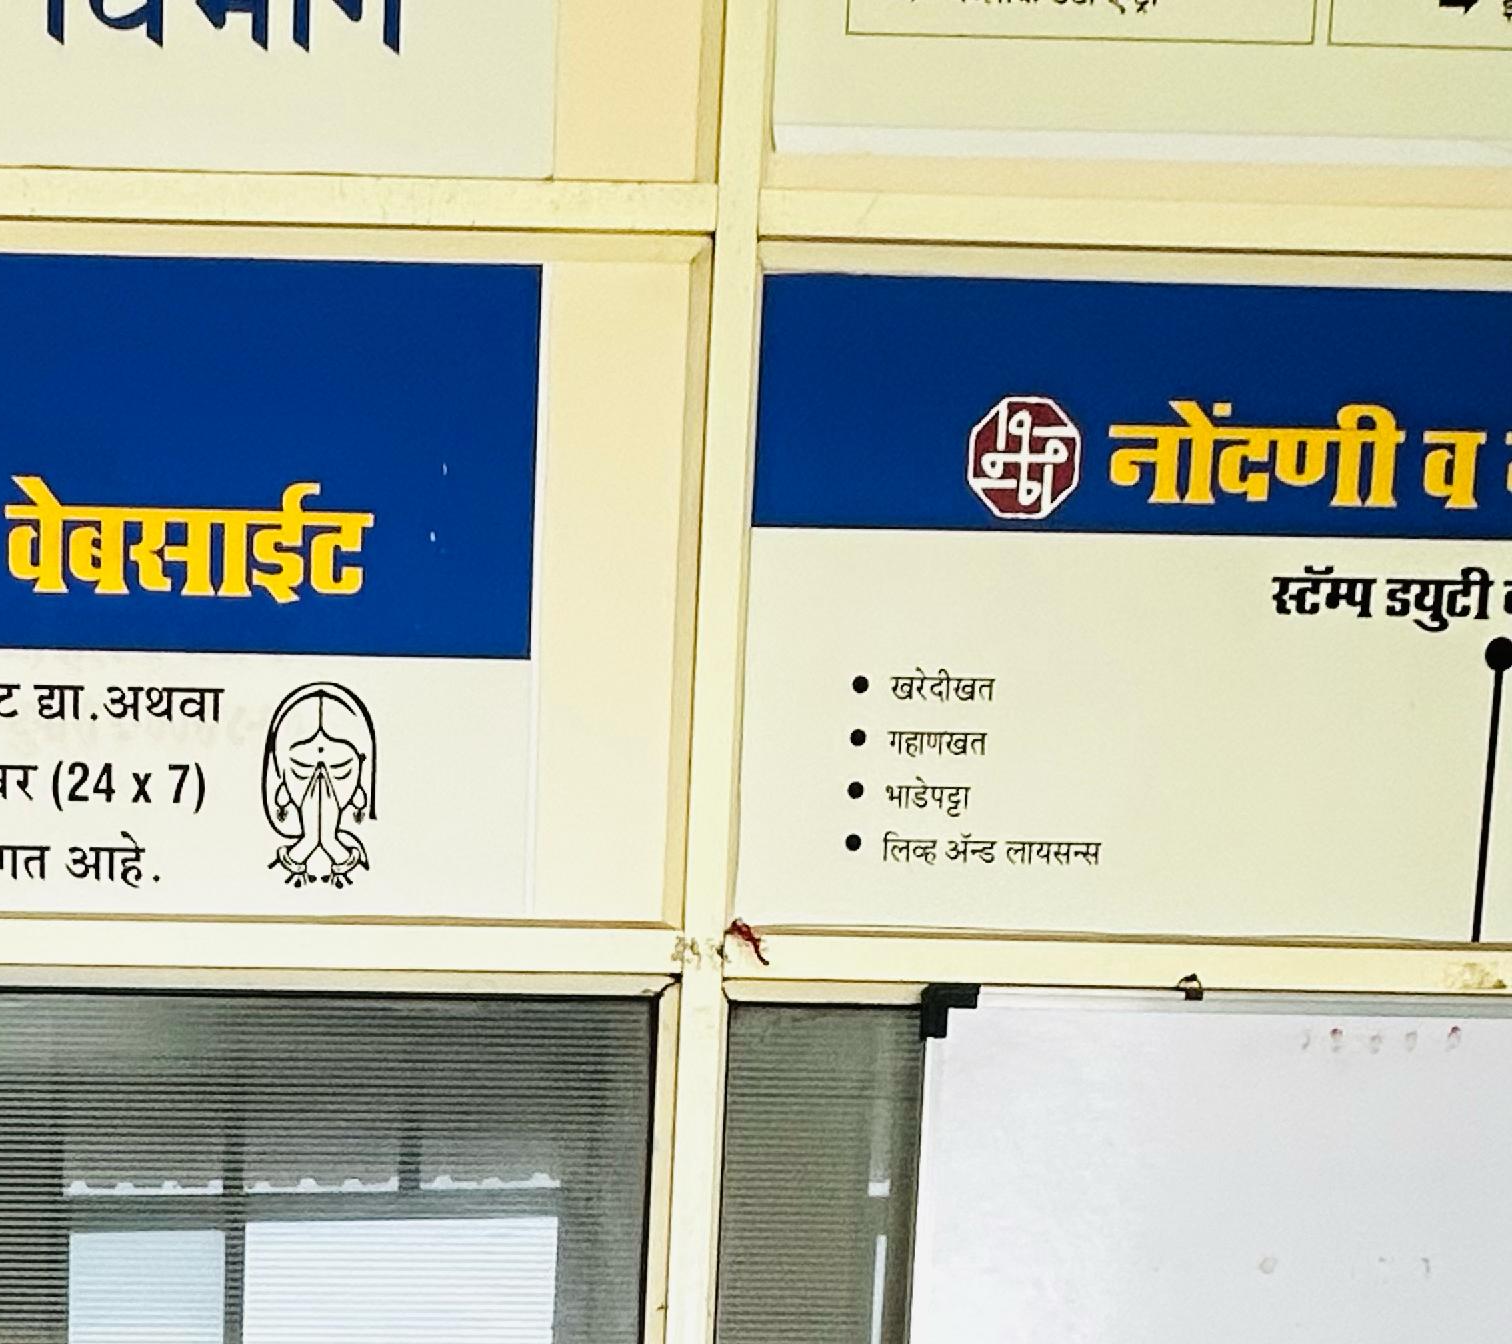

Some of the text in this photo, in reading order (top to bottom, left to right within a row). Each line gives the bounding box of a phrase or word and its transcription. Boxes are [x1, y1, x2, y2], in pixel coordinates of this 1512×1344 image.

[1108, 399, 1406, 508] नोंदणी
[1422, 430, 1487, 509] व
[4, 474, 375, 604] वेबसाईट
[890, 666, 996, 703] खरेदीखत
[887, 730, 988, 757] गहाणखत
[51, 761, 116, 812] (24
[131, 771, 153, 804] x
[167, 762, 206, 814] 7)
[885, 775, 972, 818] भाडेपट्टा
[882, 830, 938, 866] लिव्ह
[1004, 840, 1102, 866] लायसन्स
